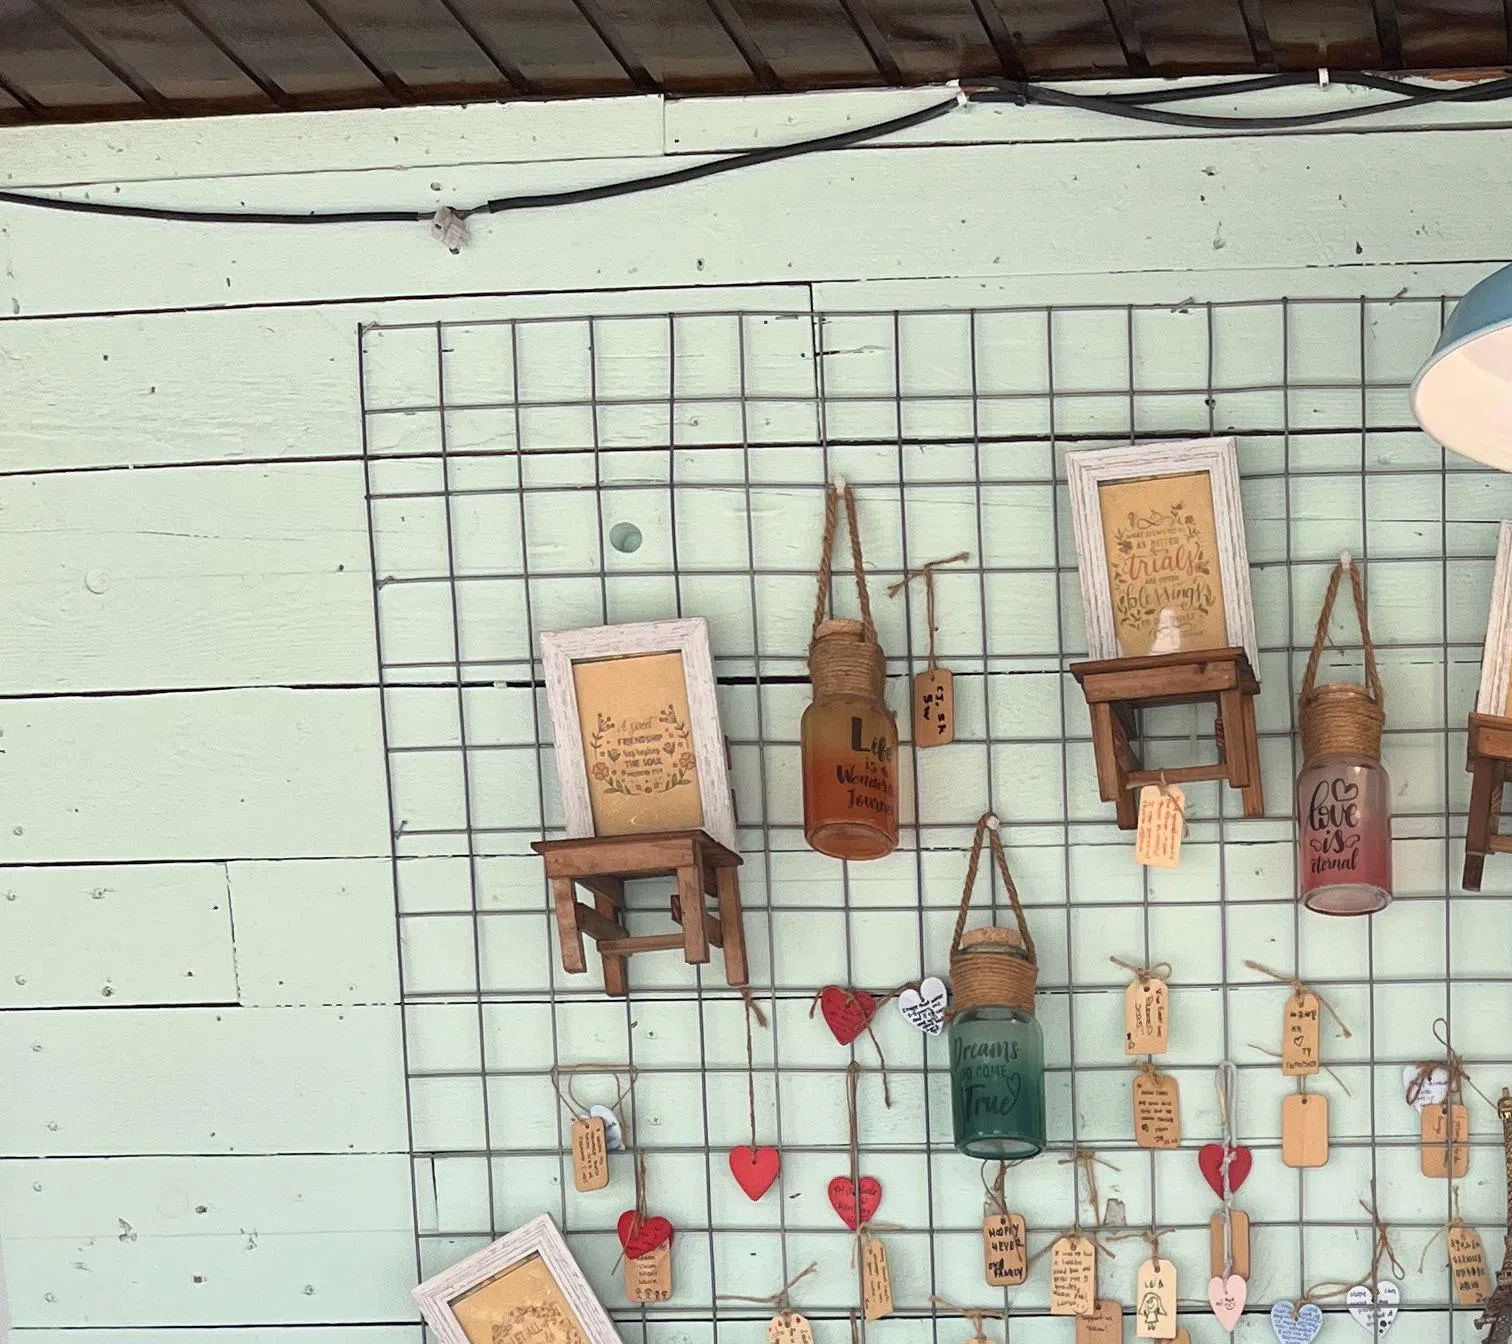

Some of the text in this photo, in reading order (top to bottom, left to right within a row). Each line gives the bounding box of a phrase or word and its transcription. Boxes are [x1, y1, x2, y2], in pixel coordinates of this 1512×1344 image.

[1310, 780, 1358, 831] love
[1323, 829, 1344, 853] is
[954, 1036, 1018, 1069] Dreams
